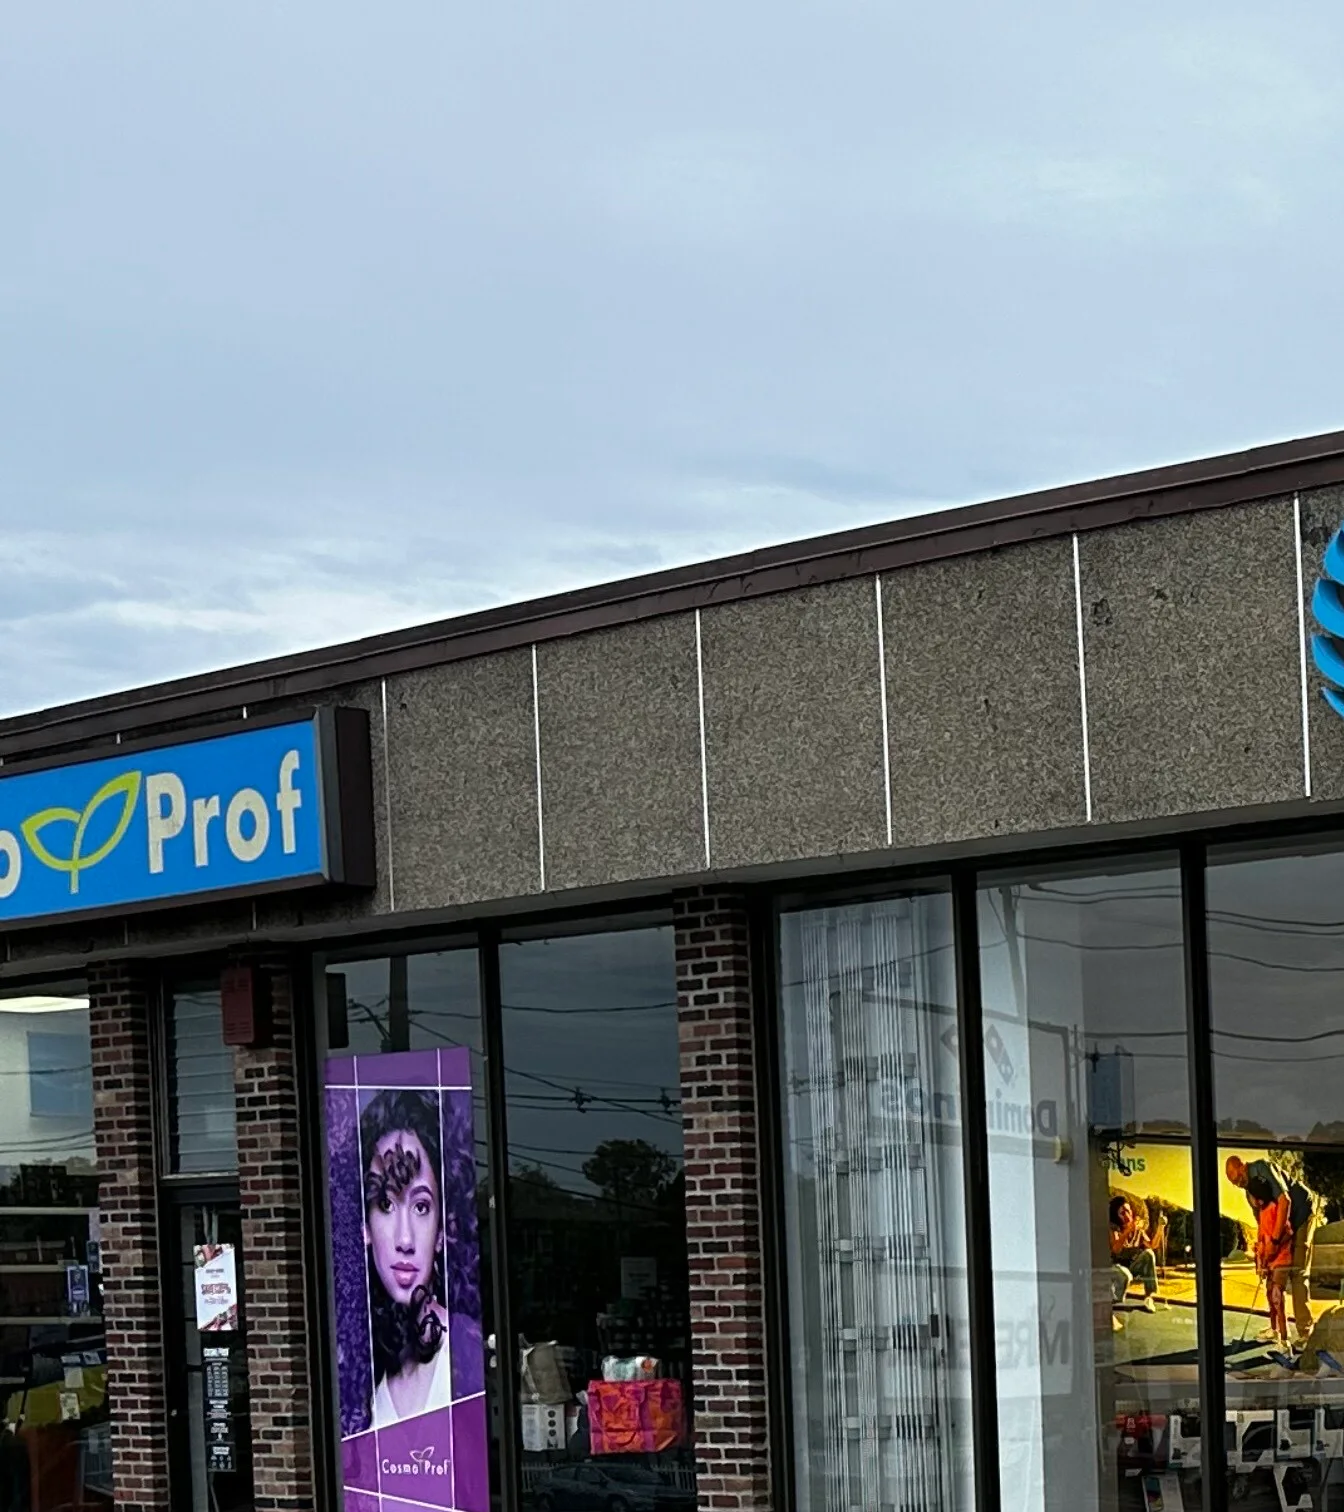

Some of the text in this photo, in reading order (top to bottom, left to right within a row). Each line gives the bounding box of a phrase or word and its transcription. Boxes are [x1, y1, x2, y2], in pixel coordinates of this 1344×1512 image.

[146, 749, 302, 874] Prof
[382, 1458, 451, 1475] Cosmo Prof
